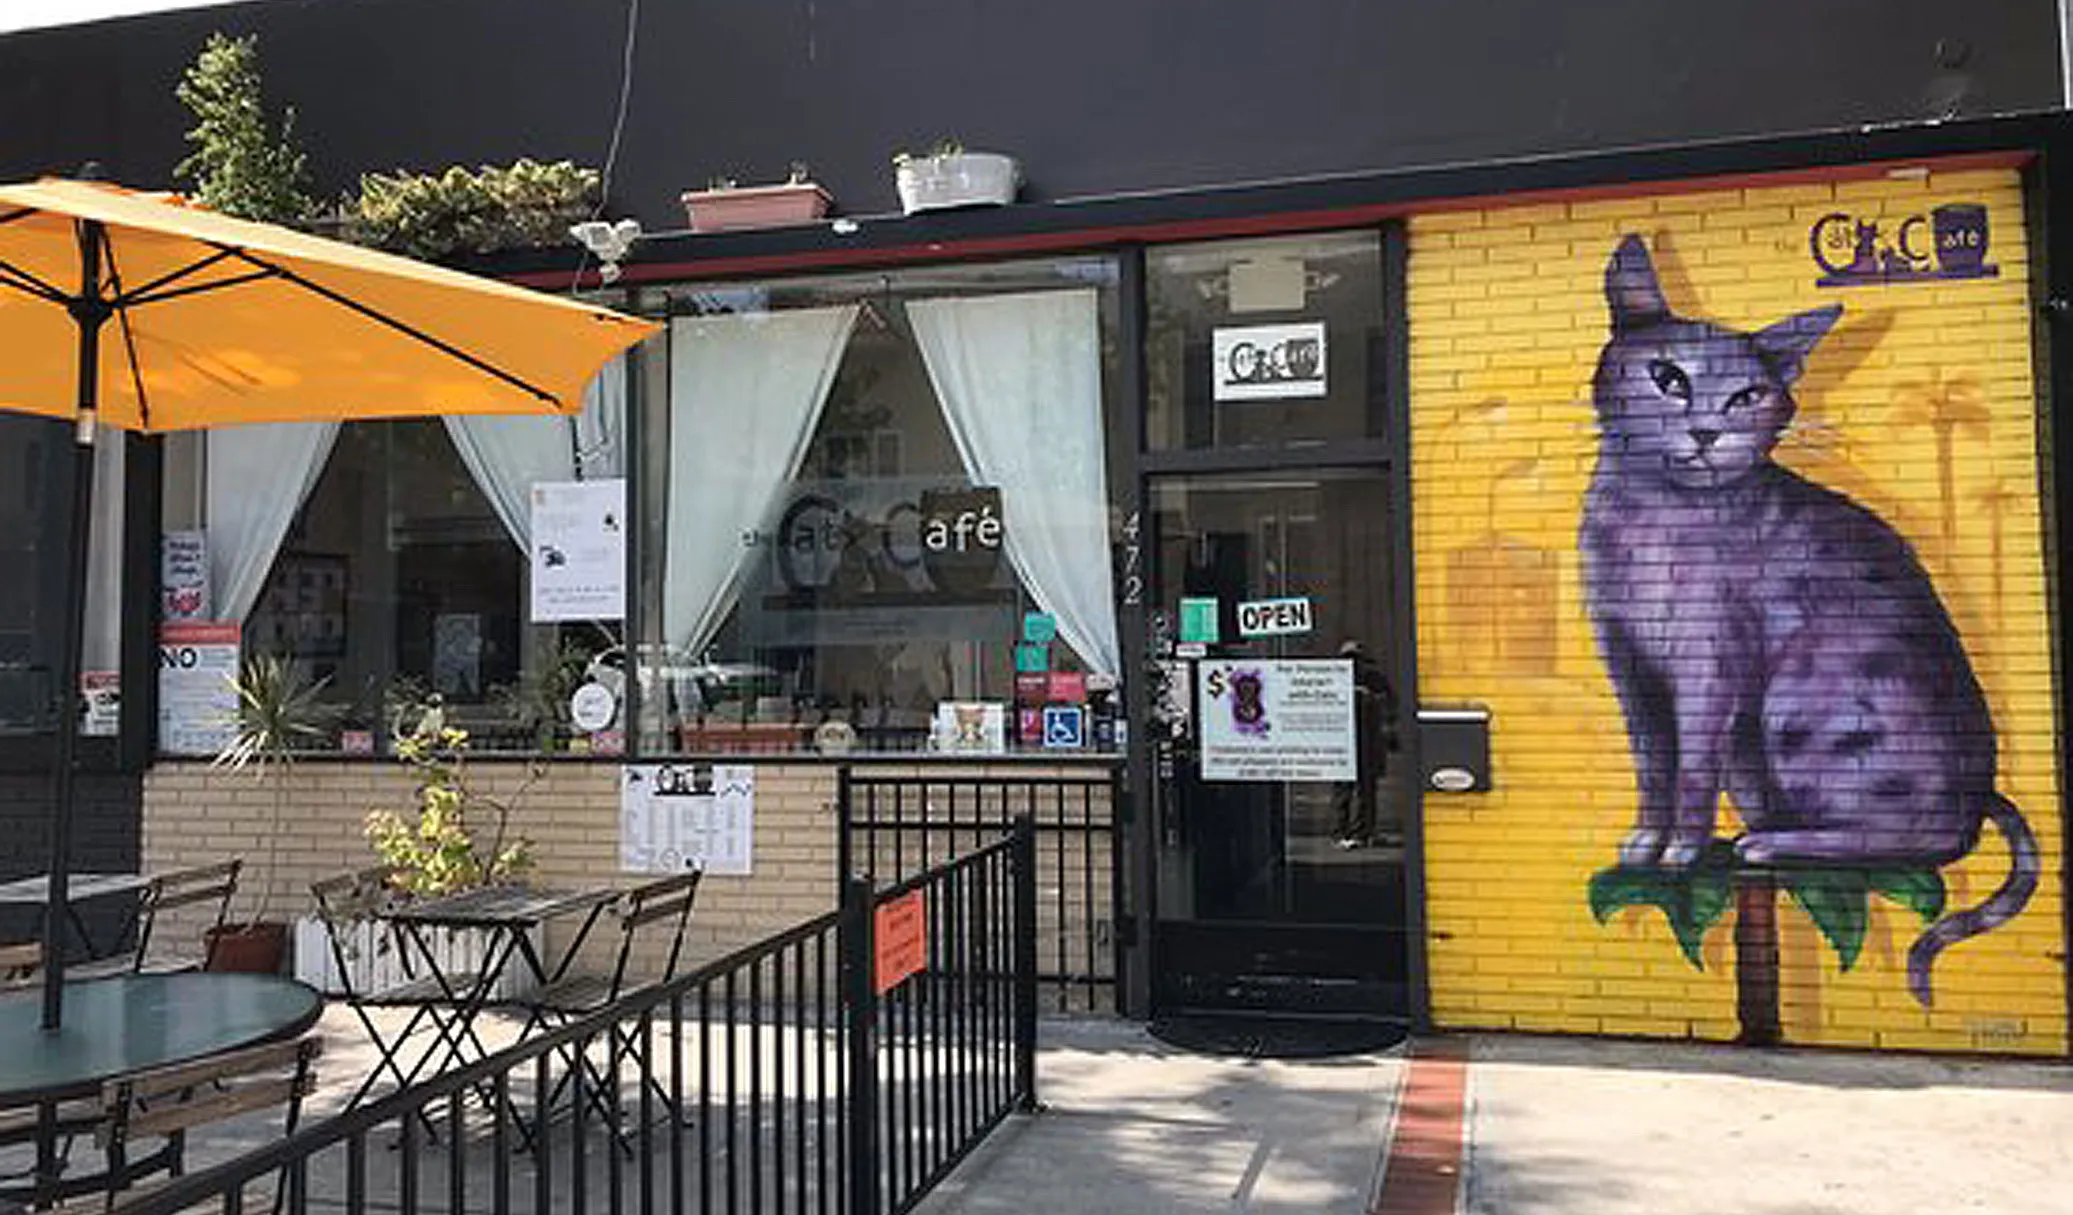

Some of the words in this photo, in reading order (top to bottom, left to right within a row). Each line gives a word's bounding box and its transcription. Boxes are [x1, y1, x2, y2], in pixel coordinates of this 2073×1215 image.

[884, 500, 1001, 568] Café
[1122, 511, 1143, 604] 472
[1242, 602, 1306, 631] OPEN
[158, 646, 197, 668] NO
